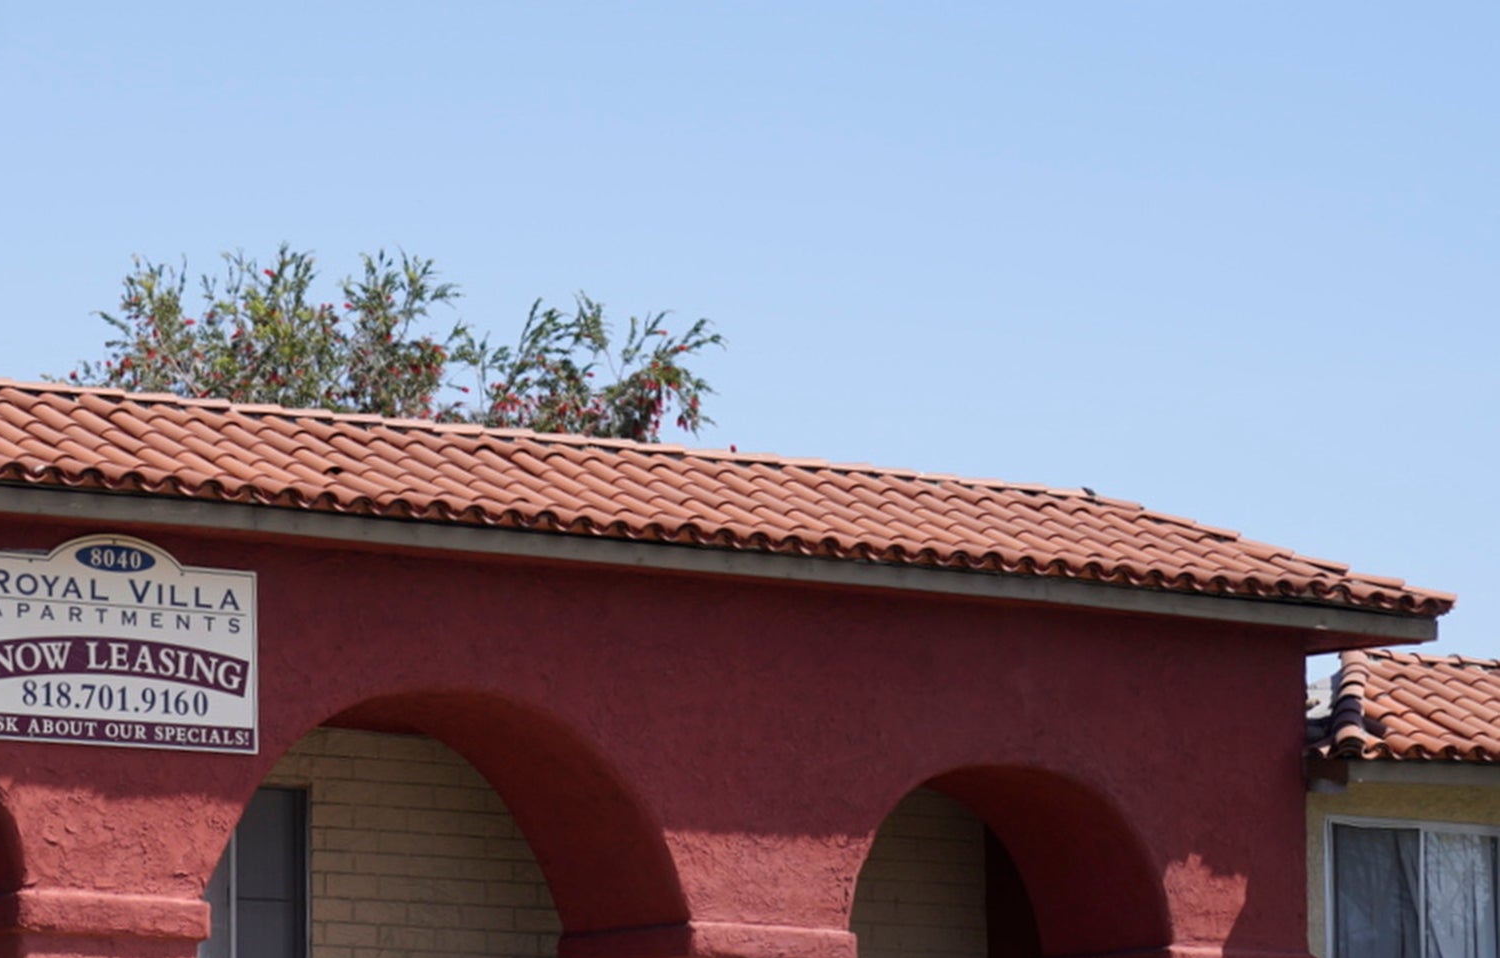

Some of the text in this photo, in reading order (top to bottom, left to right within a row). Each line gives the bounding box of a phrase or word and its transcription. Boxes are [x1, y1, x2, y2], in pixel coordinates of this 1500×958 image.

[90, 549, 142, 570] 8040
[129, 579, 241, 611] VILLA
[85, 641, 245, 691] LEASING
[22, 680, 209, 716] 818.701.9160
[28, 717, 97, 737] ABOUT
[105, 721, 147, 740] OUR
[154, 725, 250, 745] SPECIALS!
